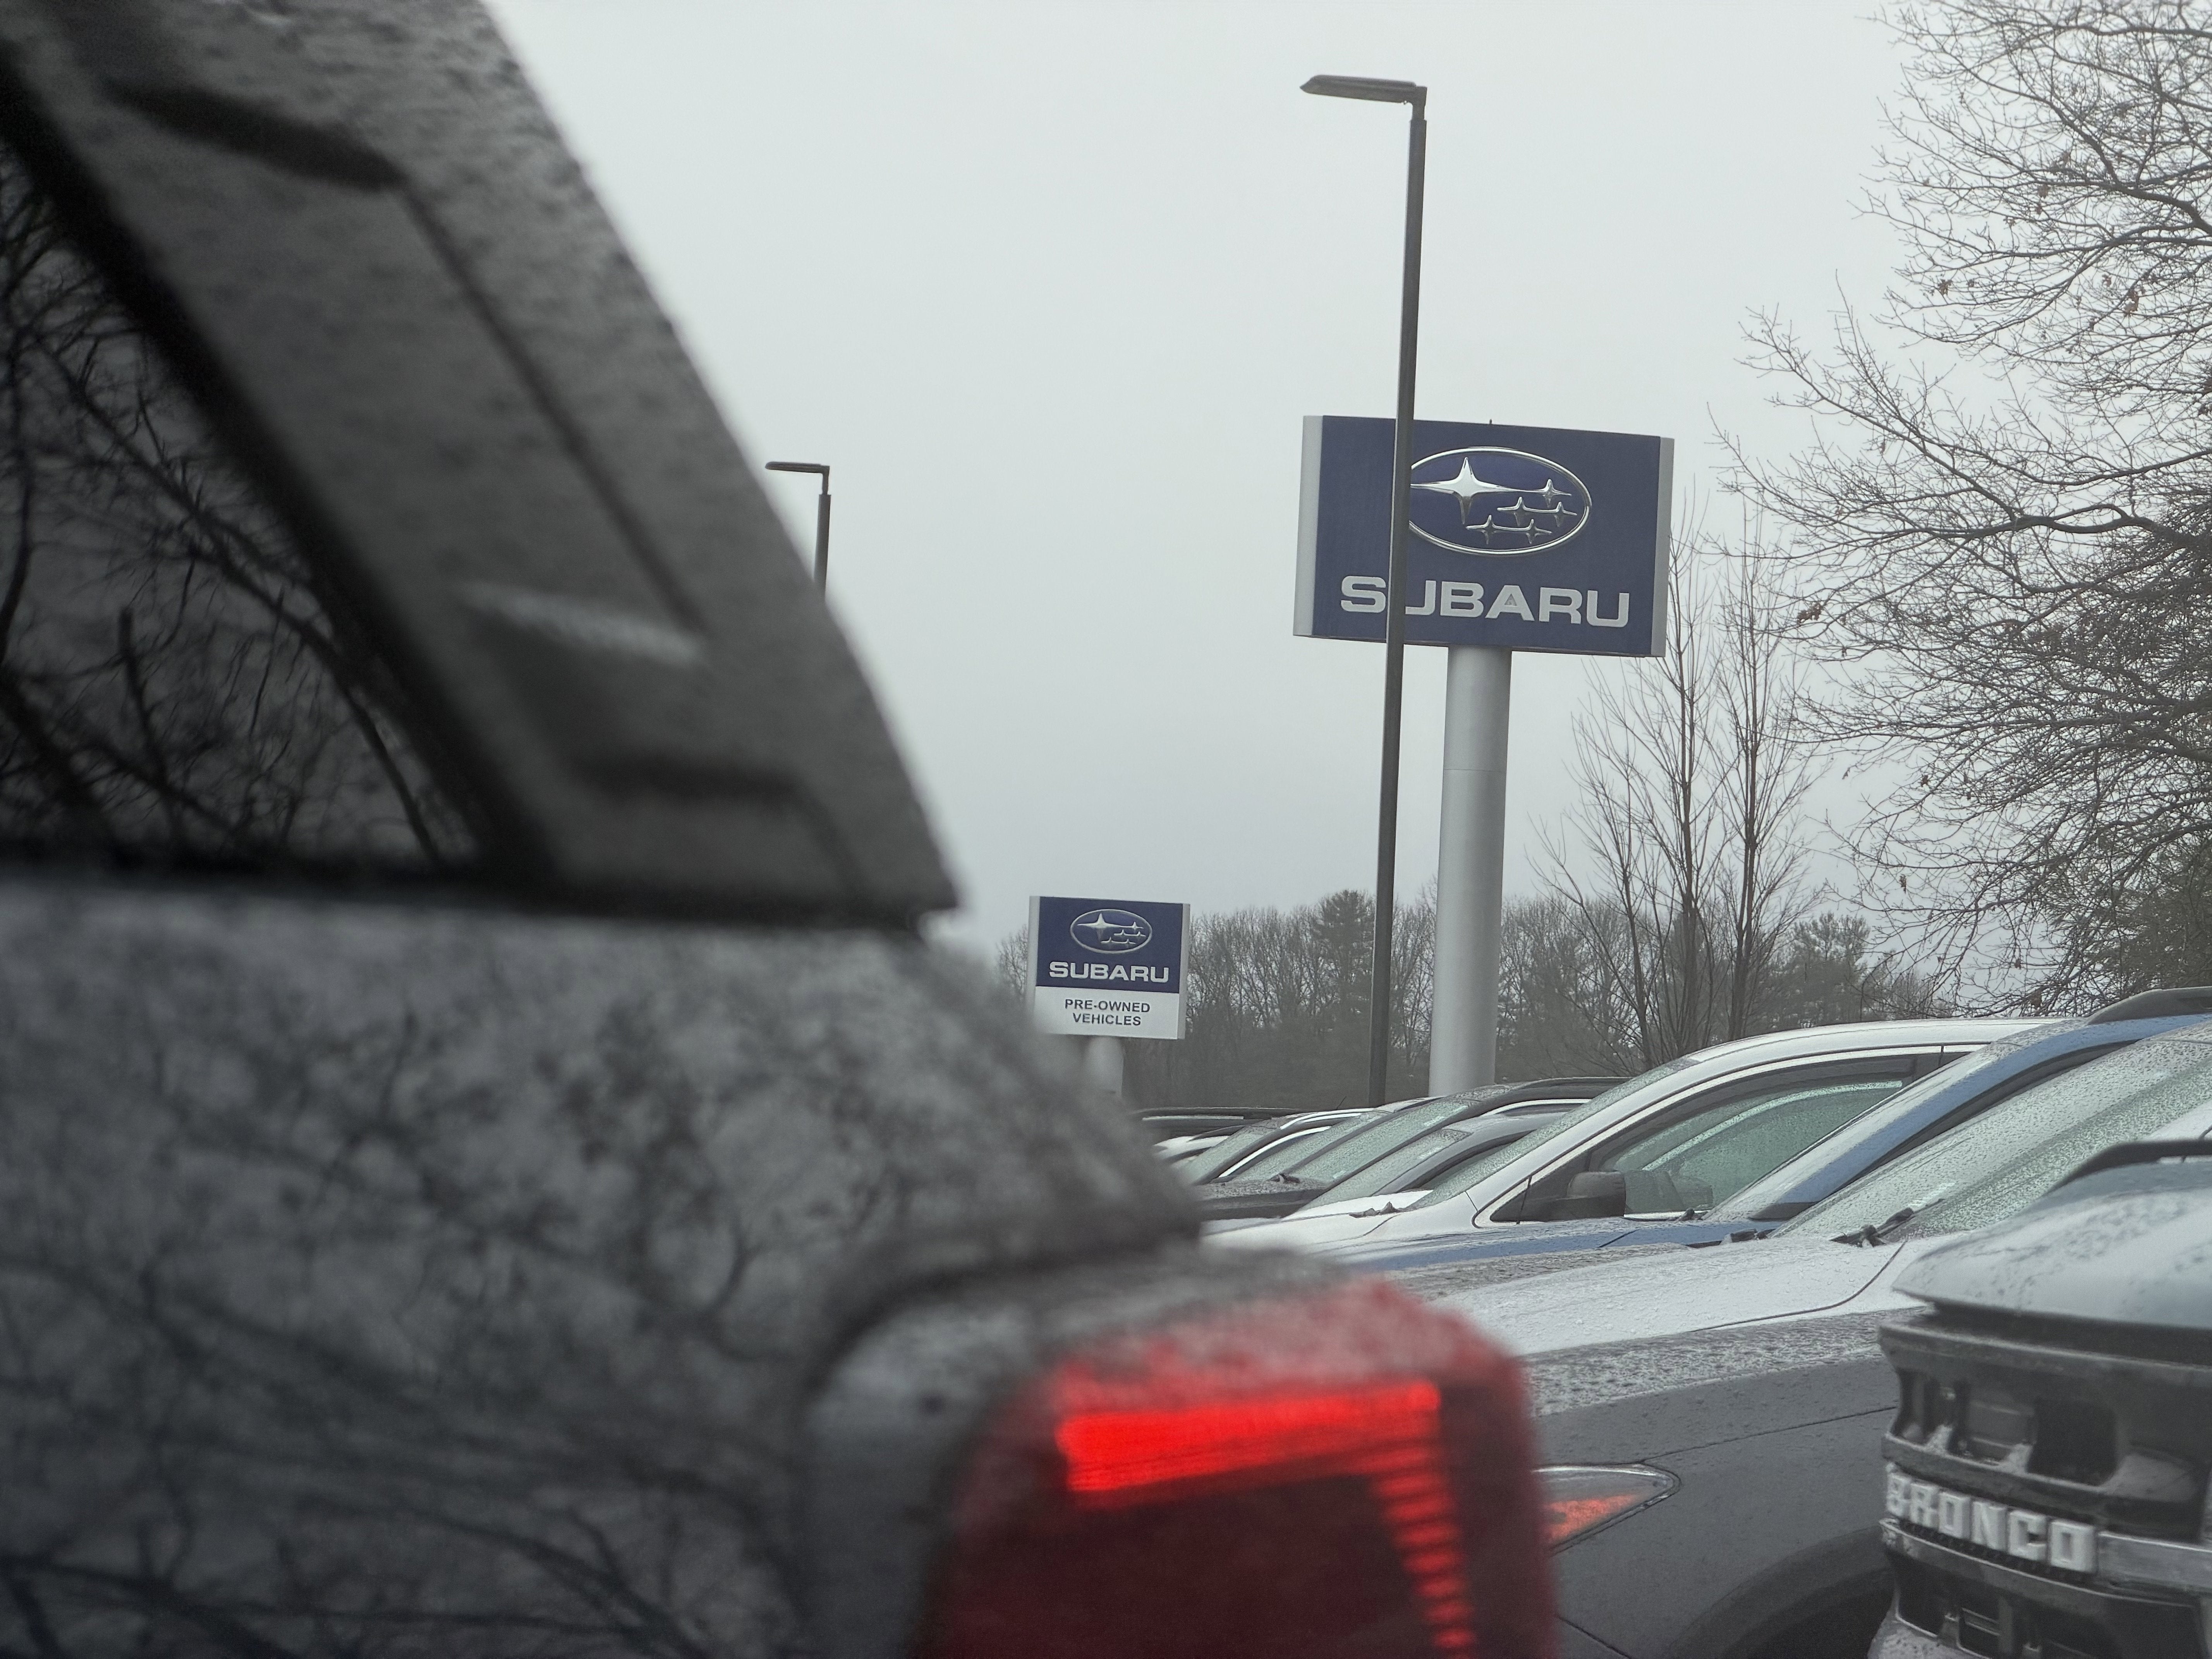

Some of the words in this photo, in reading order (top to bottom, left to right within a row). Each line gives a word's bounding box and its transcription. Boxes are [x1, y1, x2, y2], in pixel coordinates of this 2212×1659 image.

[1340, 575, 1630, 628] SUBARU
[1049, 961, 1169, 983] SUBARU
[1065, 999, 1150, 1013] PRE-OWNED
[1073, 1013, 1141, 1026] VEHICLES
[1887, 1472, 2095, 1573] BRONCO
